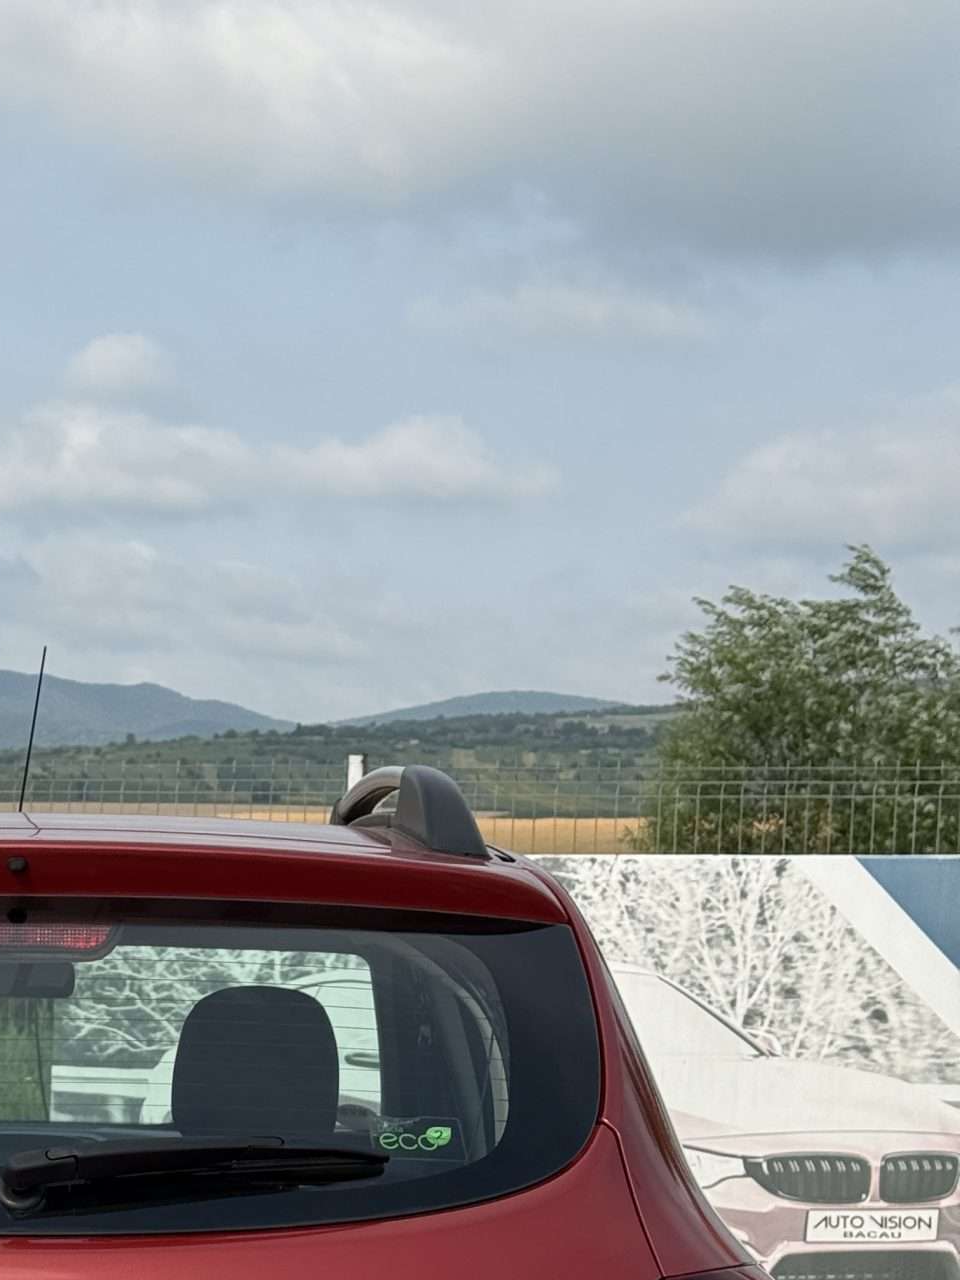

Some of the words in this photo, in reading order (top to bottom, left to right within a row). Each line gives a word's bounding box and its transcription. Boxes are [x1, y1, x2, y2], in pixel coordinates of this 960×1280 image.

[813, 1215, 864, 1229] AUTO
[869, 1215, 932, 1230] VISION
[843, 1231, 902, 1240] BACAU
